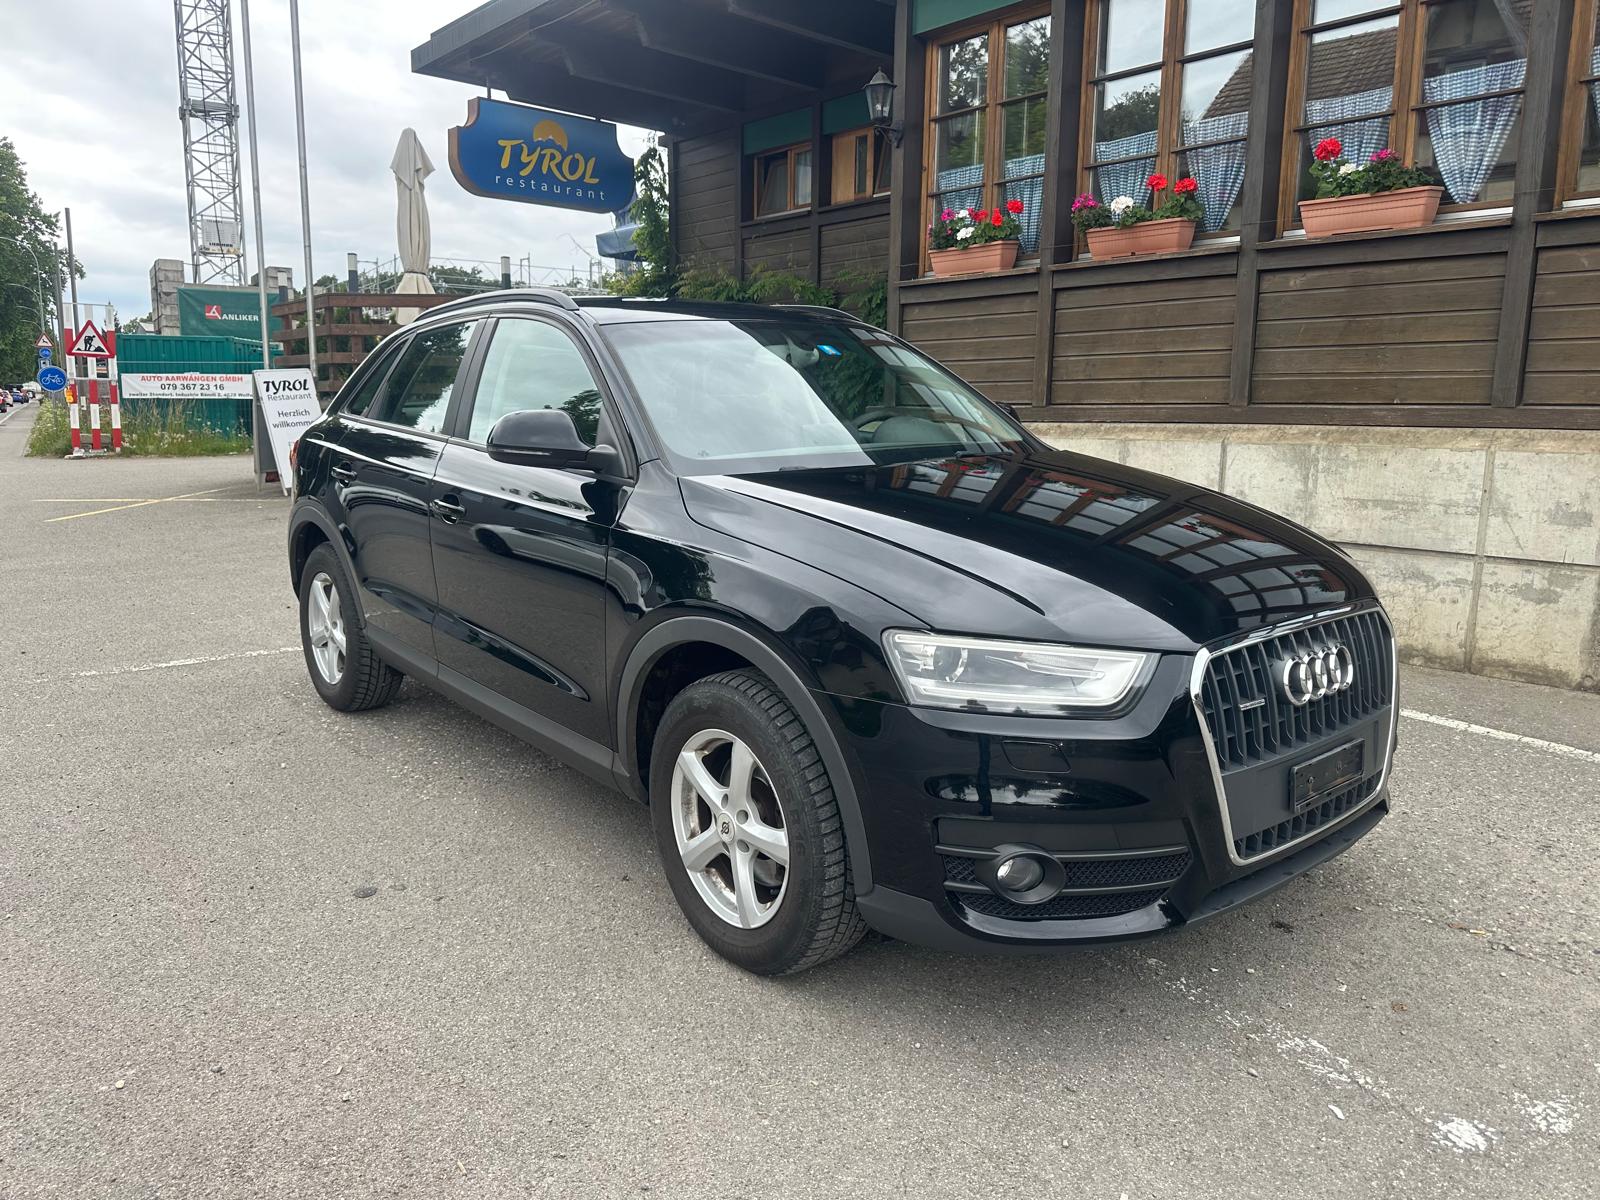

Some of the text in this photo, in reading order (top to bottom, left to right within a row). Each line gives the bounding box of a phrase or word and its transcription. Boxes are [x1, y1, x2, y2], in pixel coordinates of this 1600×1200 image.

[498, 139, 600, 184] TYROL
[495, 176, 605, 201] restaurant
[221, 313, 259, 322] ANLIKER
[160, 383, 225, 391] 079 367 23 16
[263, 379, 309, 394] TYROL
[267, 392, 312, 401] Restaurant
[277, 408, 310, 418] Herzlich
